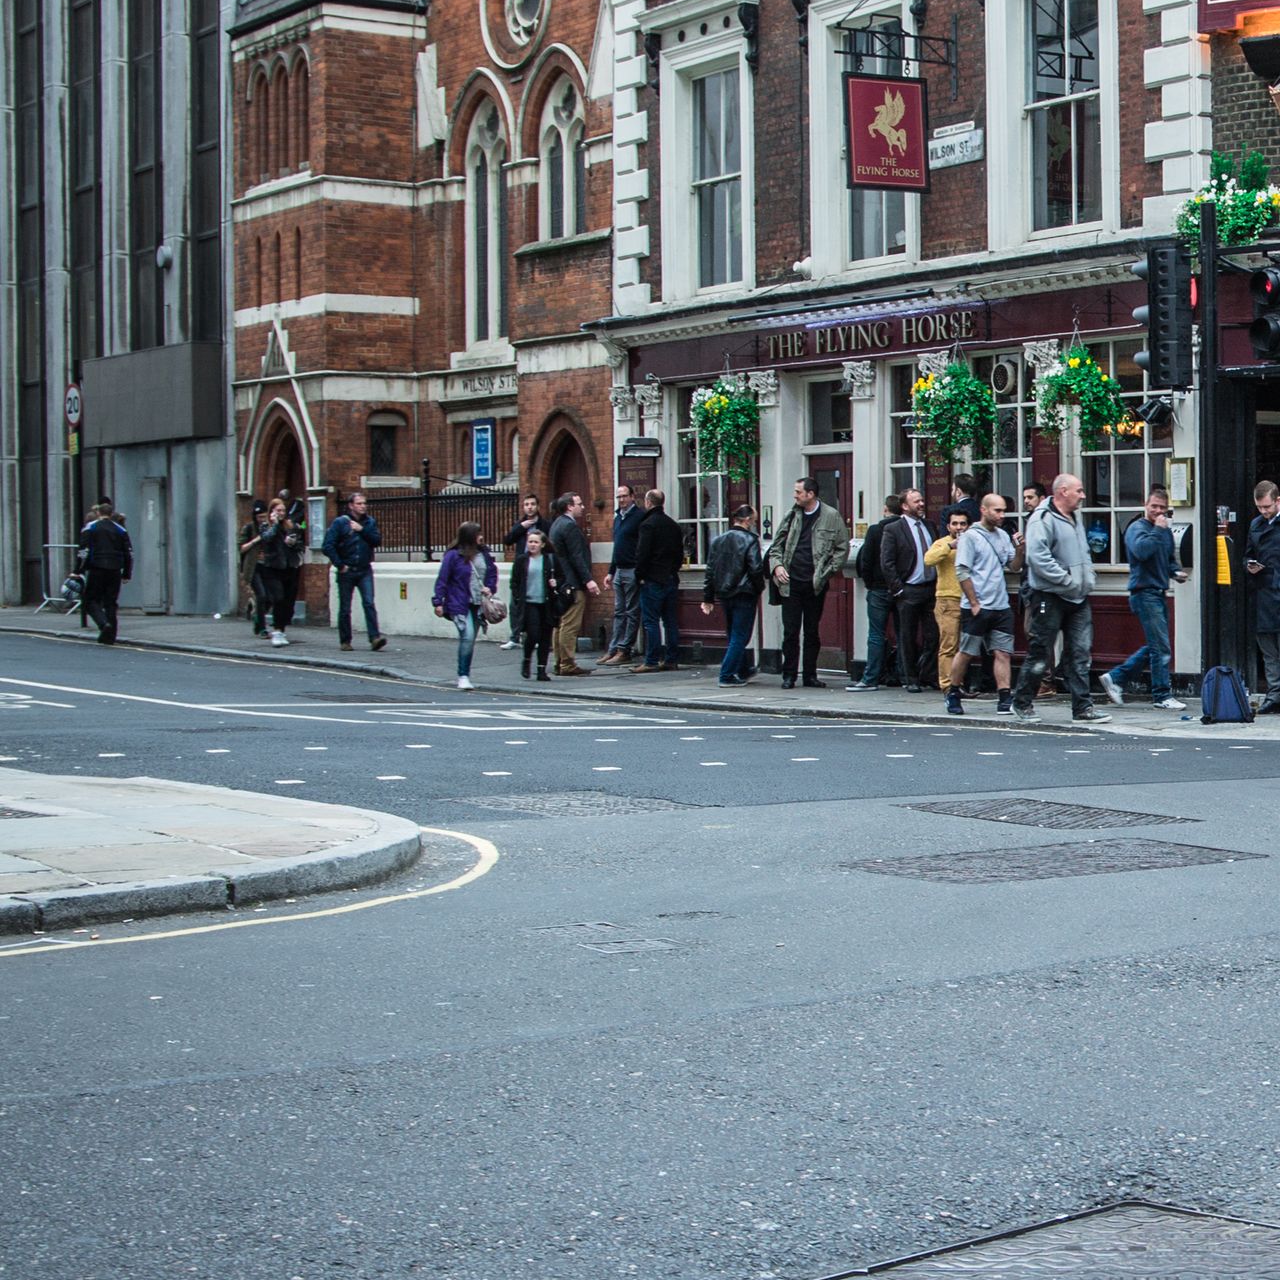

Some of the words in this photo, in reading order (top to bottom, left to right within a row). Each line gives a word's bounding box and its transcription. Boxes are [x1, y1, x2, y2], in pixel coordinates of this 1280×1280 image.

[857, 165, 888, 177] FLYING
[891, 167, 920, 178] HORSE
[880, 157, 897, 167] THE
[767, 331, 804, 359] THE
[815, 322, 890, 354] FLYING
[902, 310, 974, 345] HORSE
[462, 375, 494, 393] WILSON
[498, 373, 518, 389] STR
[67, 395, 79, 414] 20
